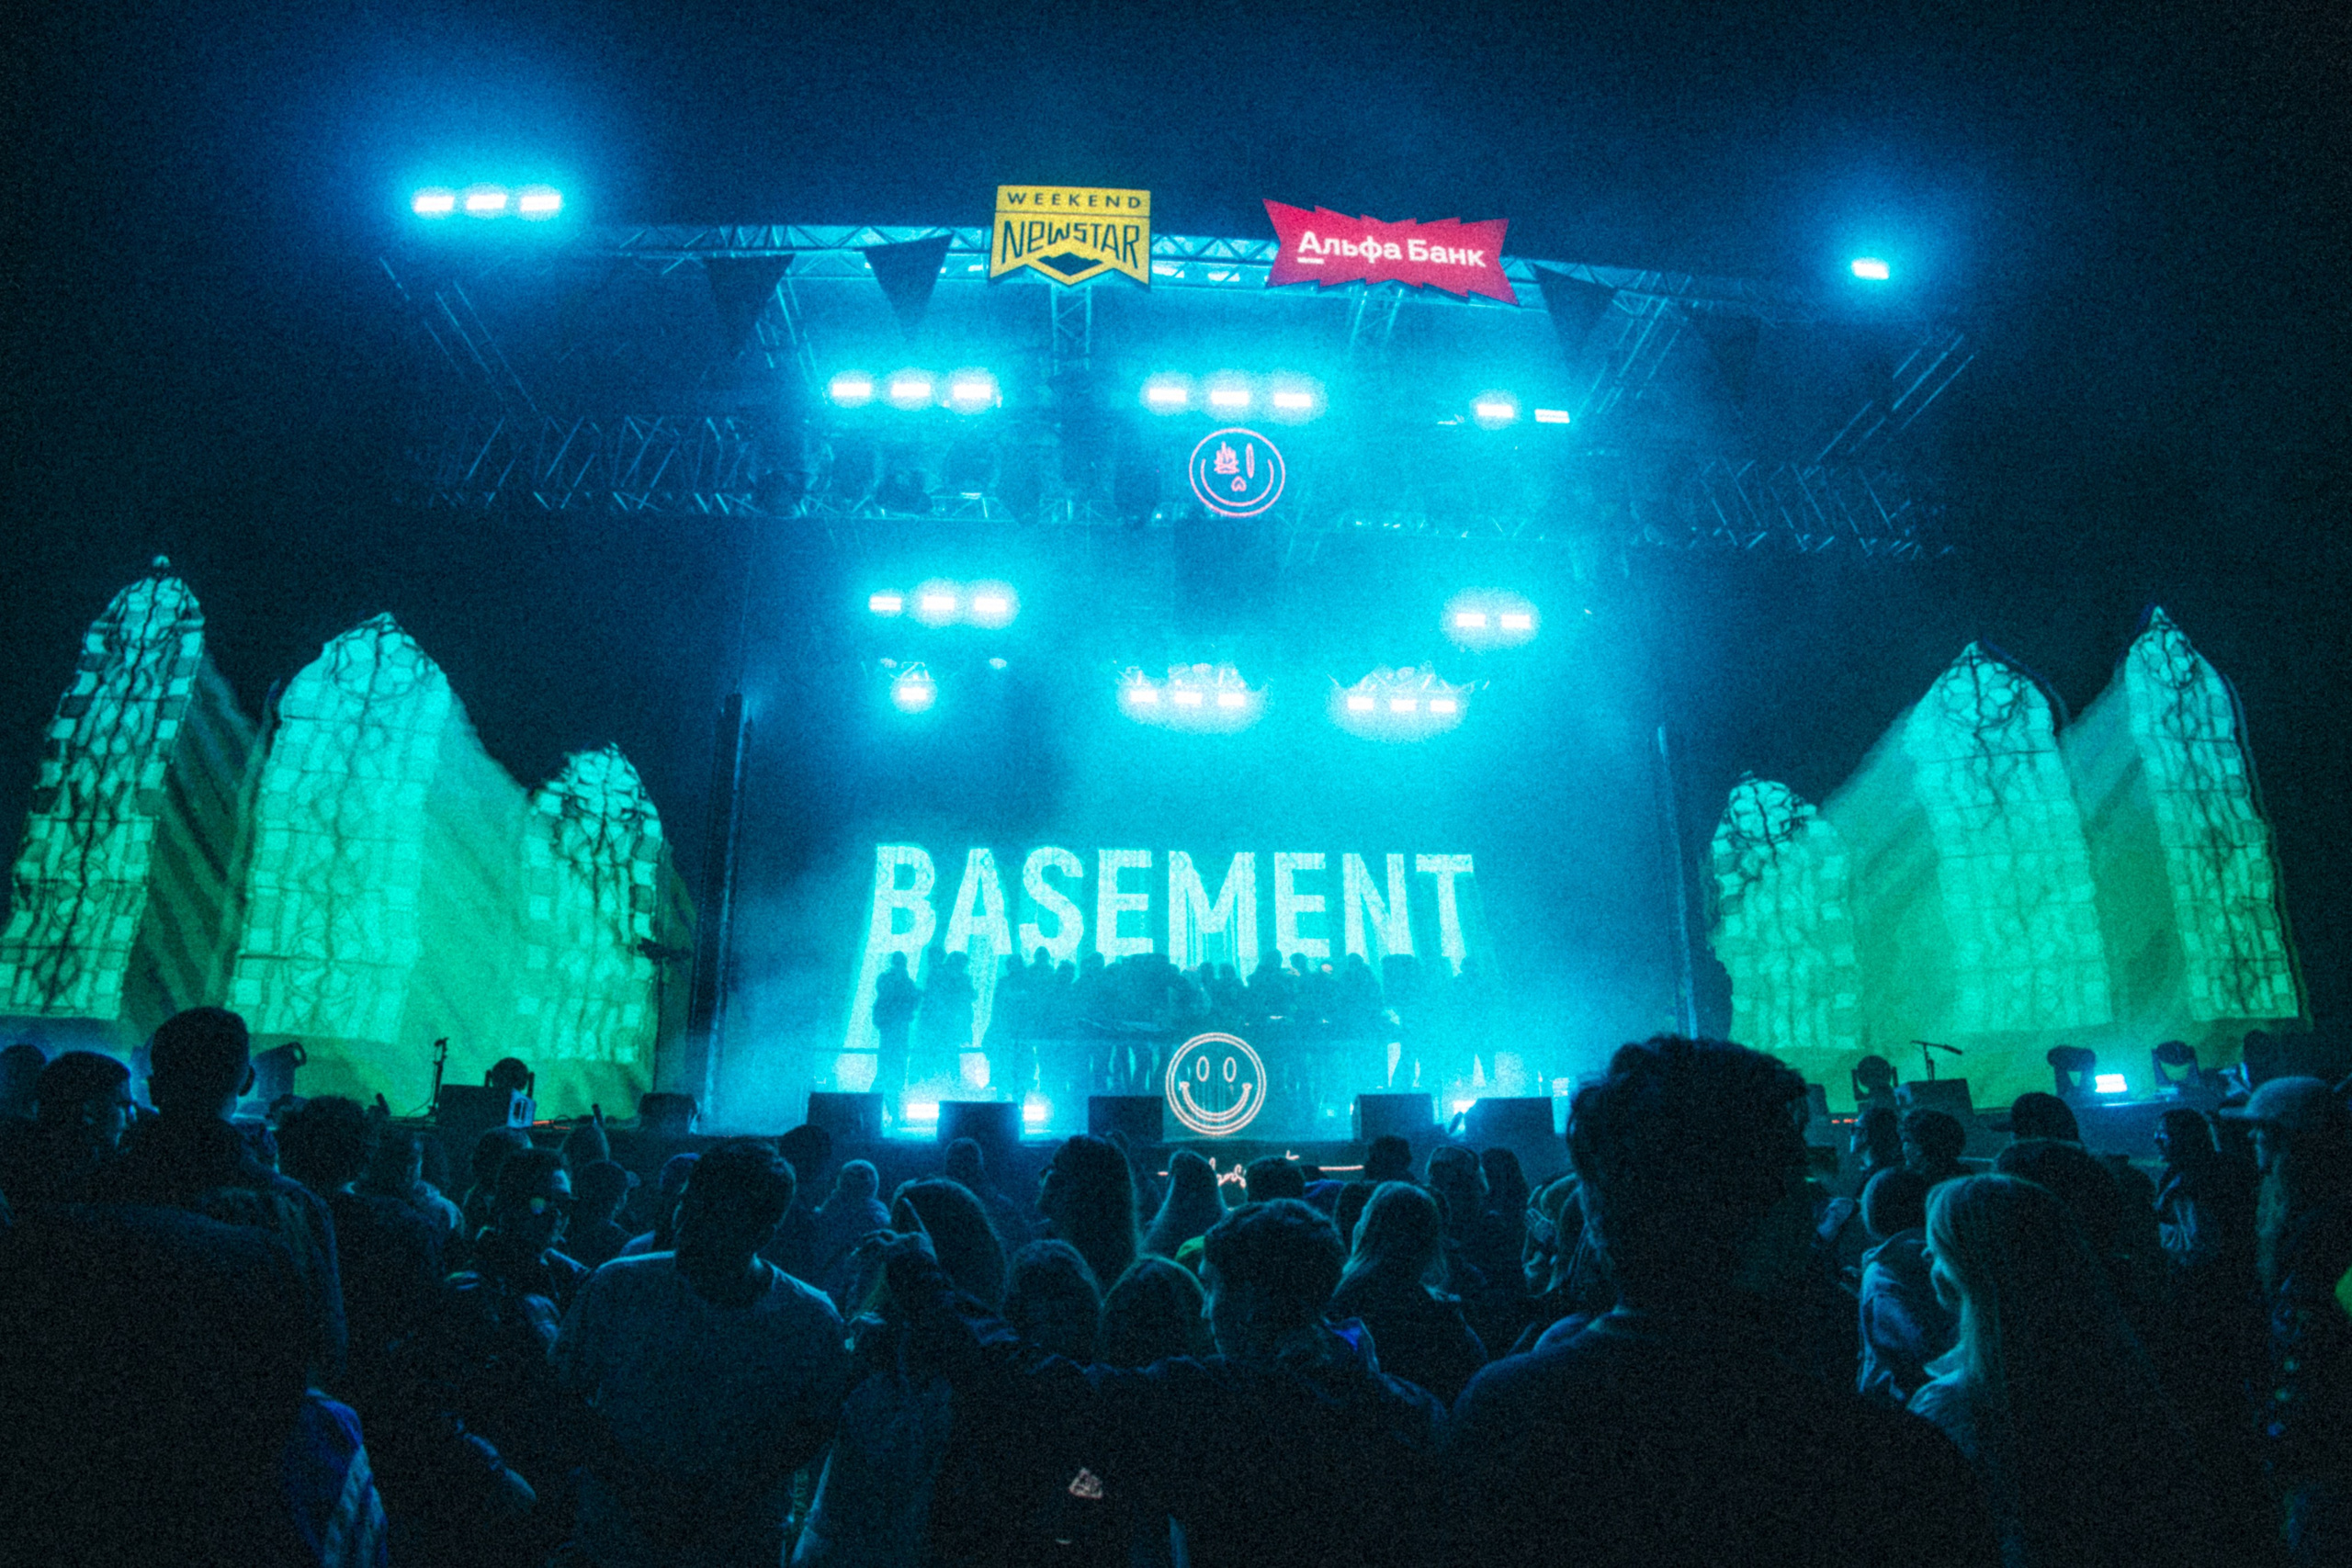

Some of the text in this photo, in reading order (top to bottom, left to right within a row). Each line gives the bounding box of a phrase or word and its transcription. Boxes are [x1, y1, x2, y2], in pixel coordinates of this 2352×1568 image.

[1007, 192, 1141, 209] WEEKEND
[1297, 231, 1487, 268] Альфа Банк
[866, 843, 1474, 976] BASEMENT
